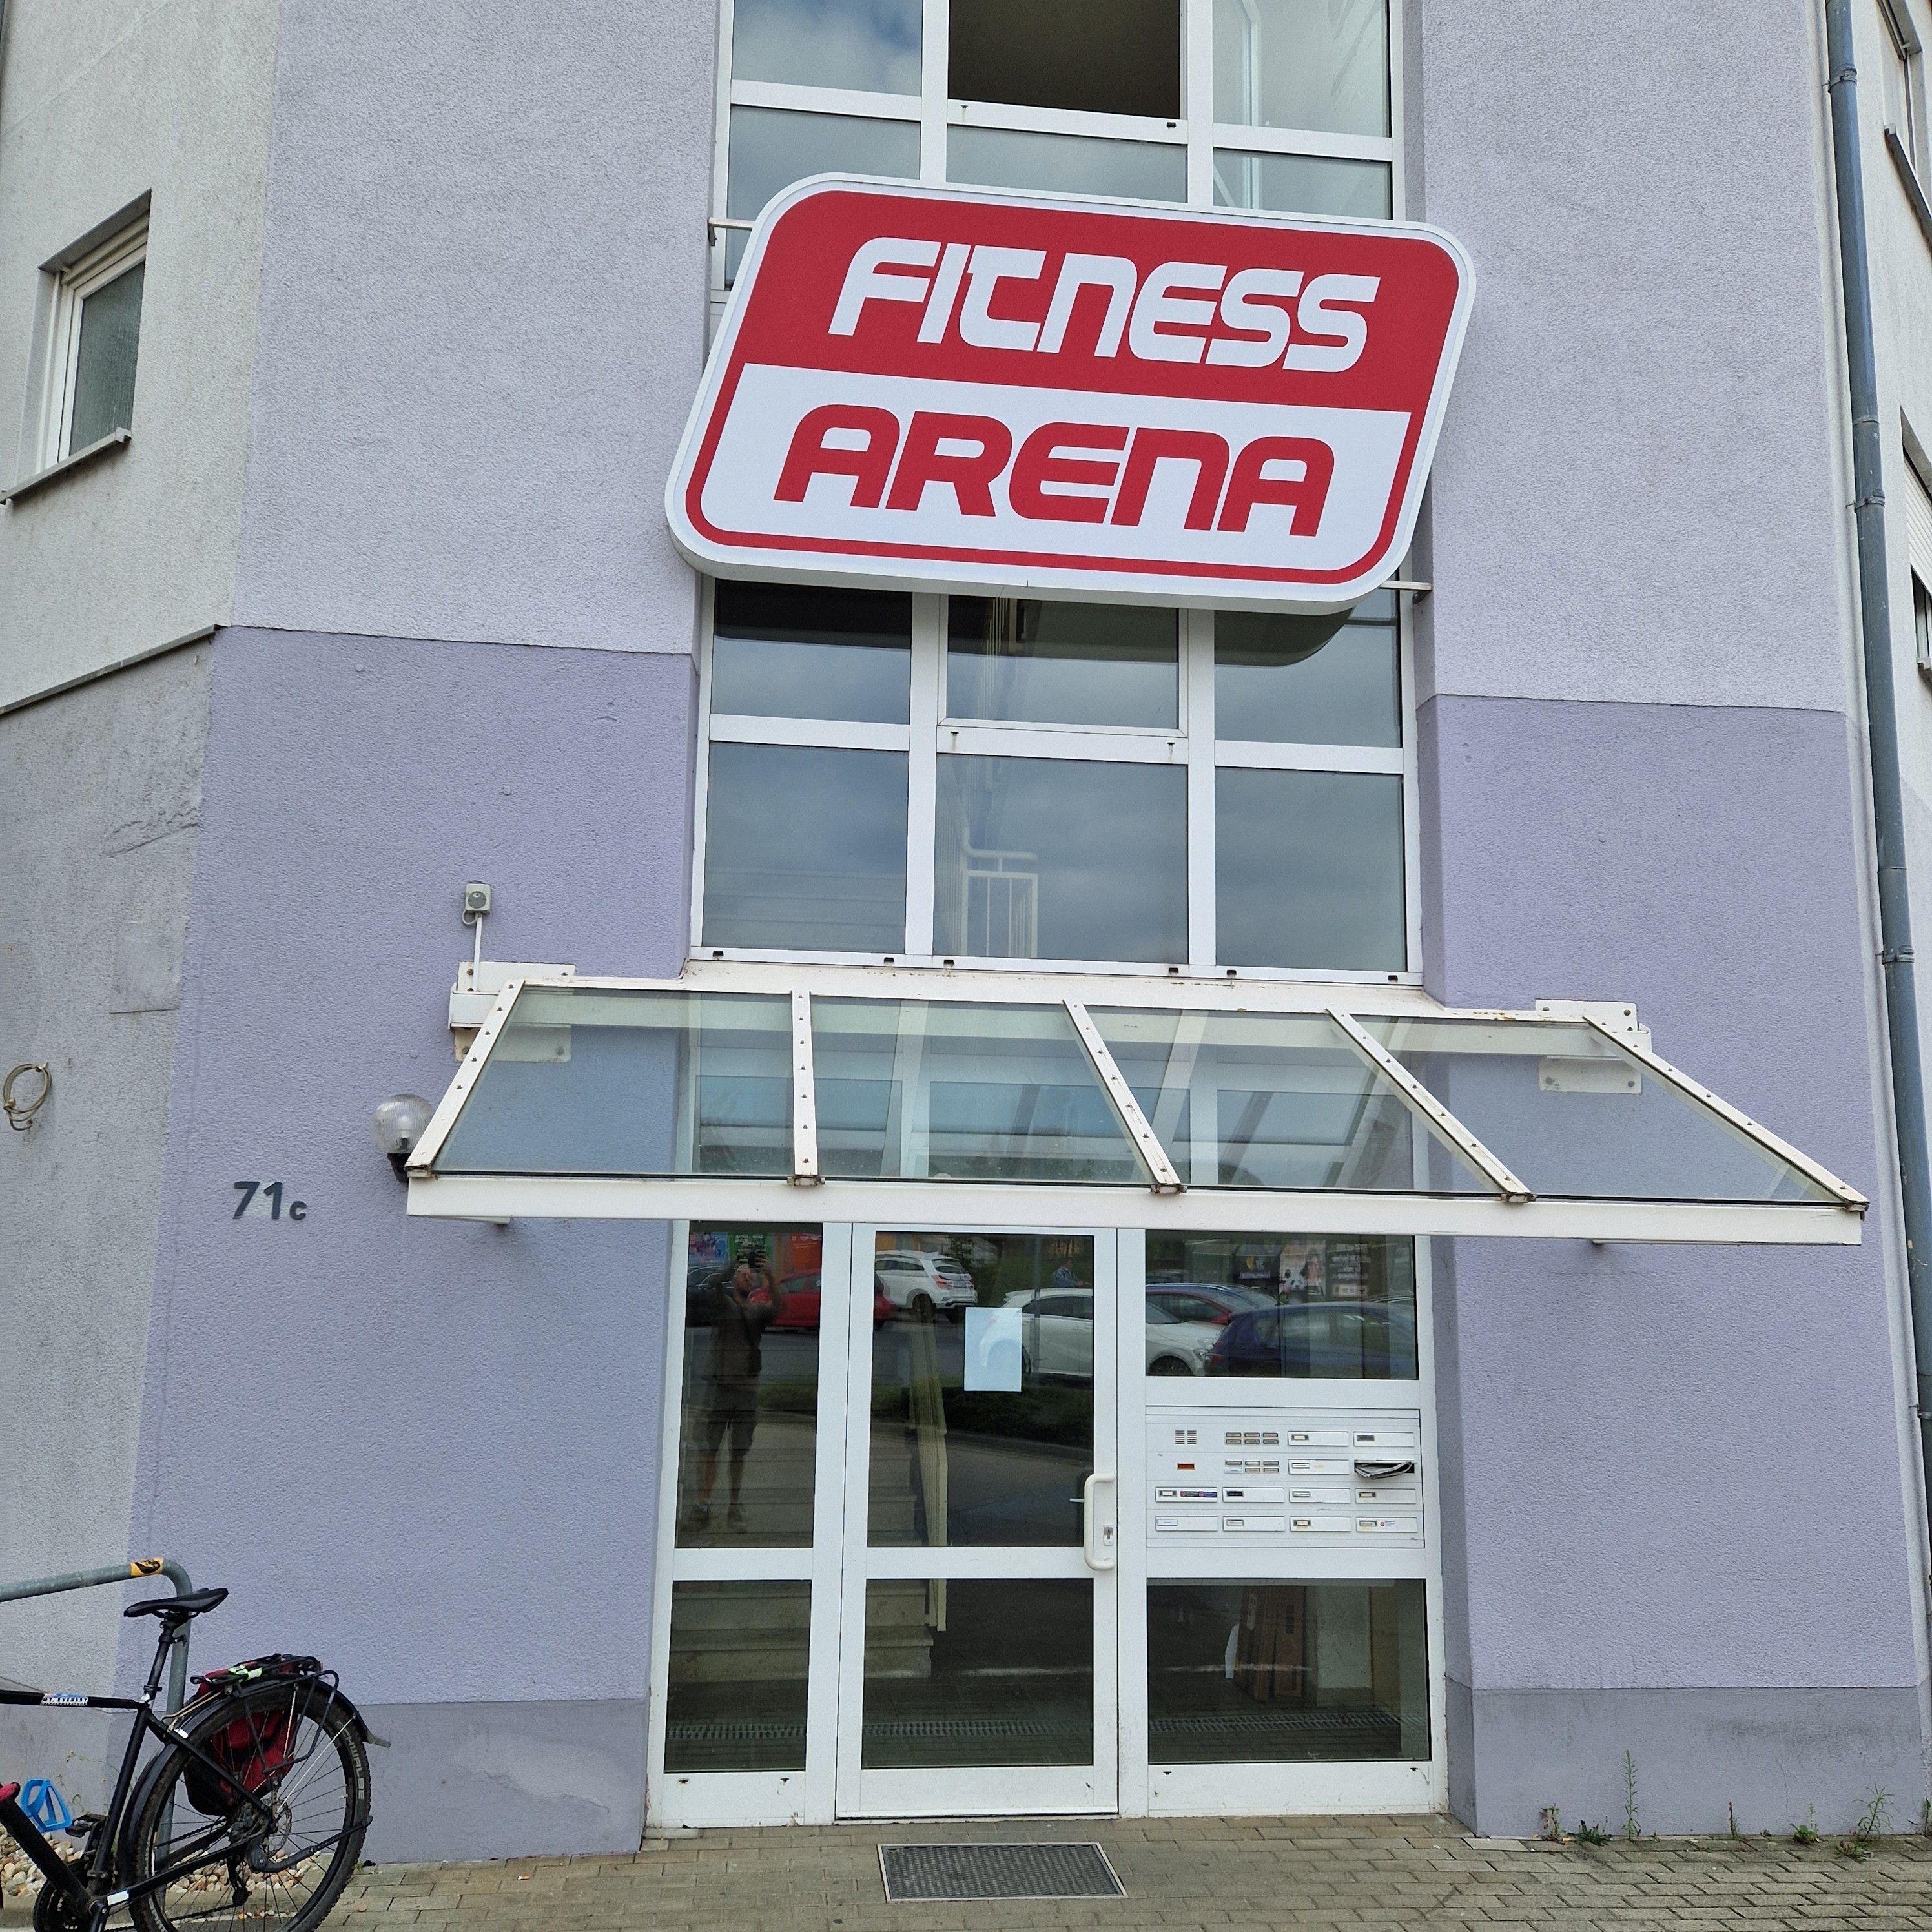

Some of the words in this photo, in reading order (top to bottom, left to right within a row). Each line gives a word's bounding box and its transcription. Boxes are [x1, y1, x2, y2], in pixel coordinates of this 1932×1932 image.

[827, 236, 1381, 373] FITNESS
[774, 404, 1335, 537] ARENA
[336, 1720, 365, 1800] SCHWALBE
